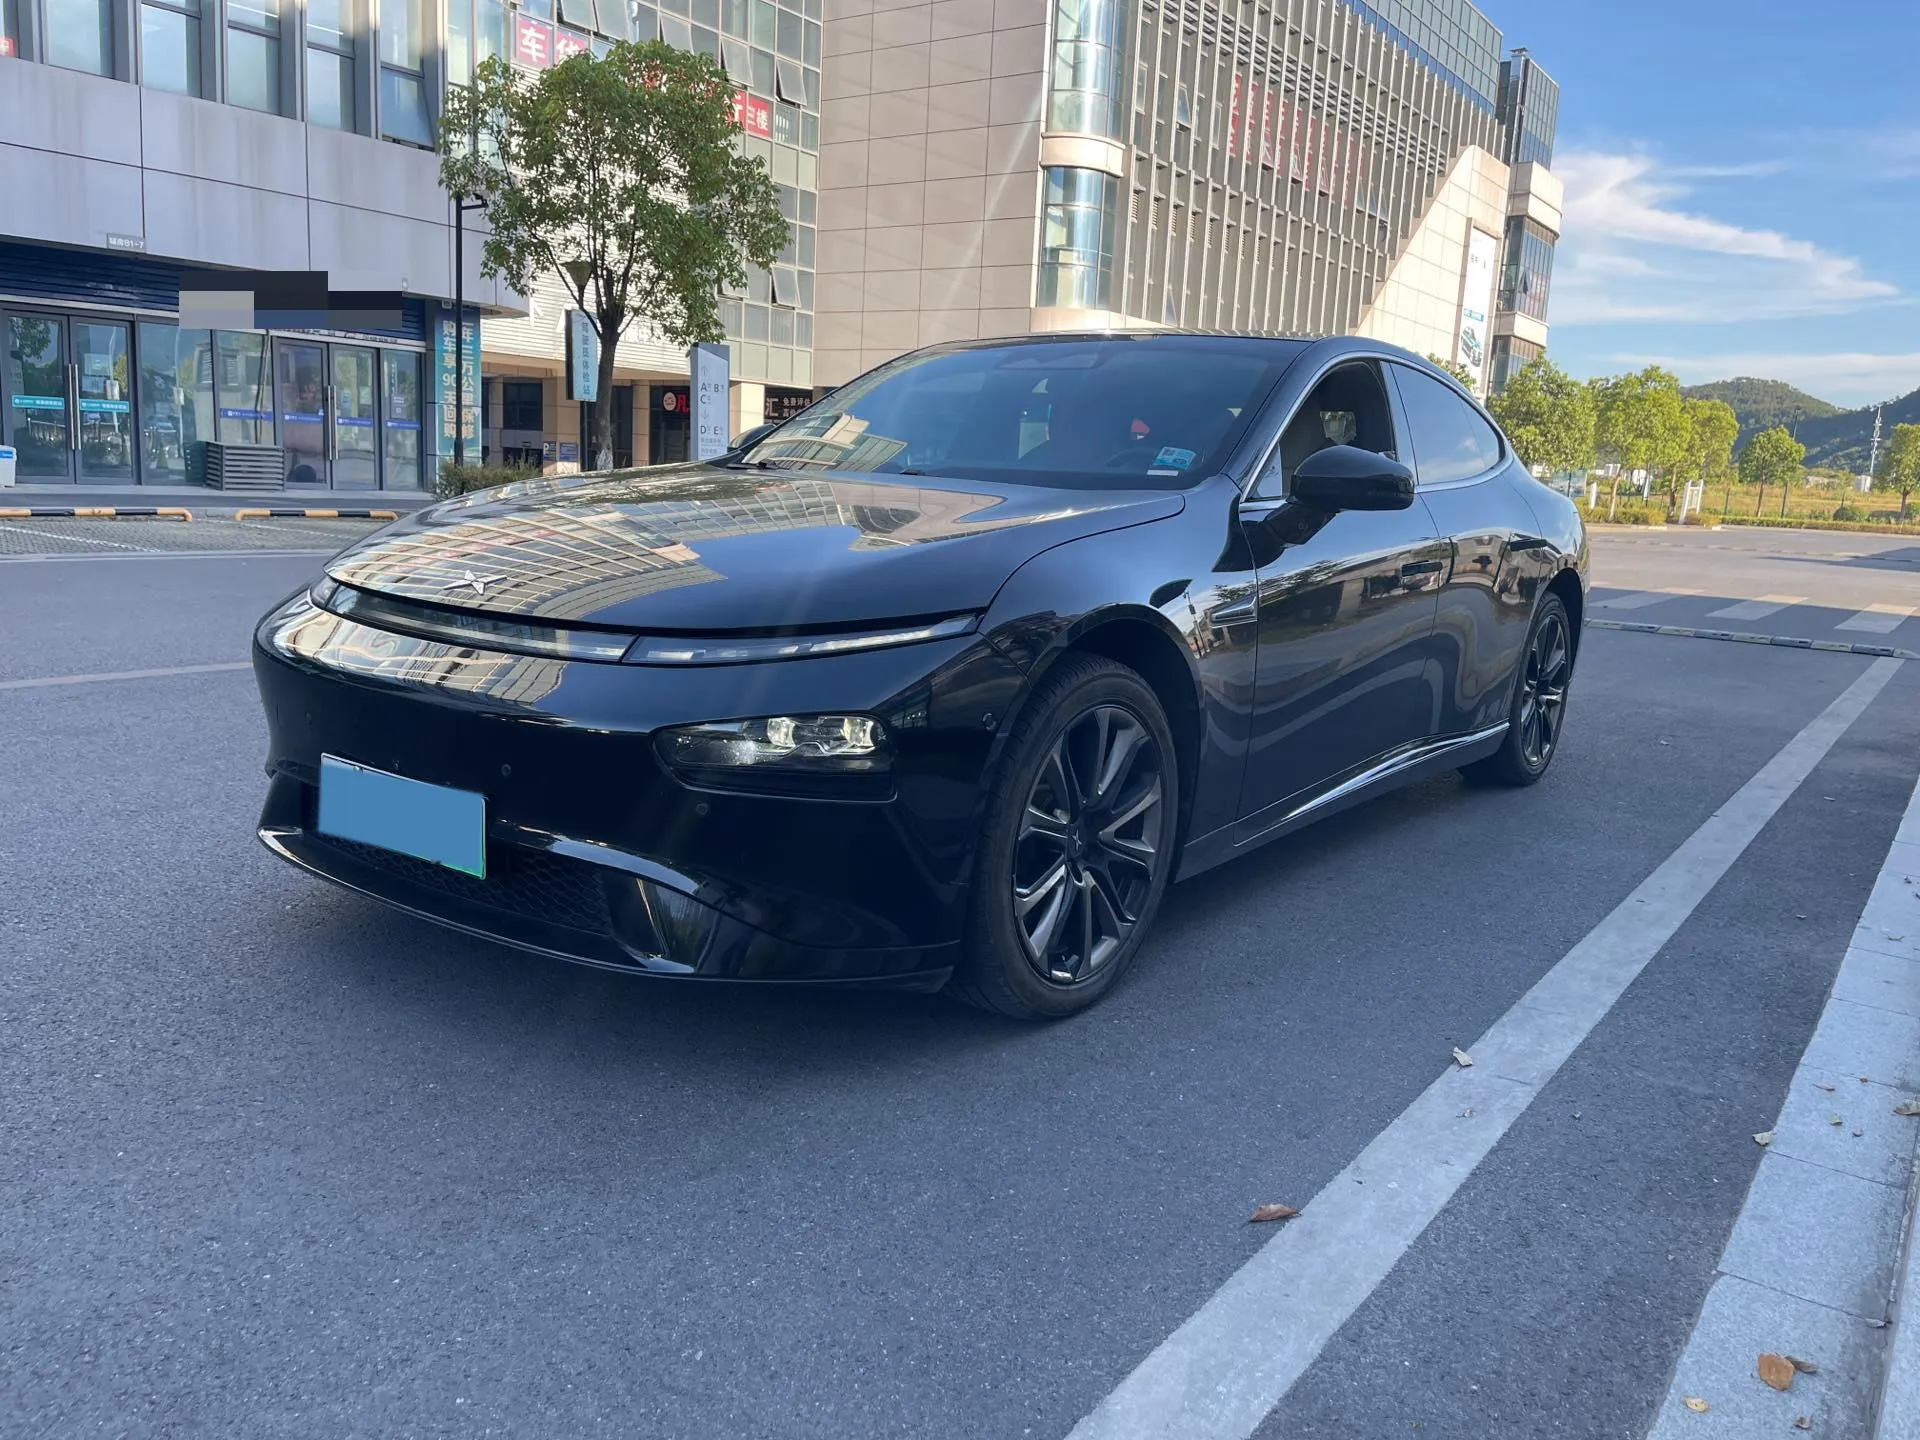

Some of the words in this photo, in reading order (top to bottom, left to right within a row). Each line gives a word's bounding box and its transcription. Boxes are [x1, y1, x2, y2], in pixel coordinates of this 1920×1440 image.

[747, 106, 768, 131] 三楼
[701, 383, 707, 392] A
[714, 384, 719, 393] B
[700, 395, 706, 404] C
[783, 397, 811, 407] 免费评估
[765, 398, 779, 417] 汇
[700, 426, 706, 434] D
[714, 427, 719, 435] E
